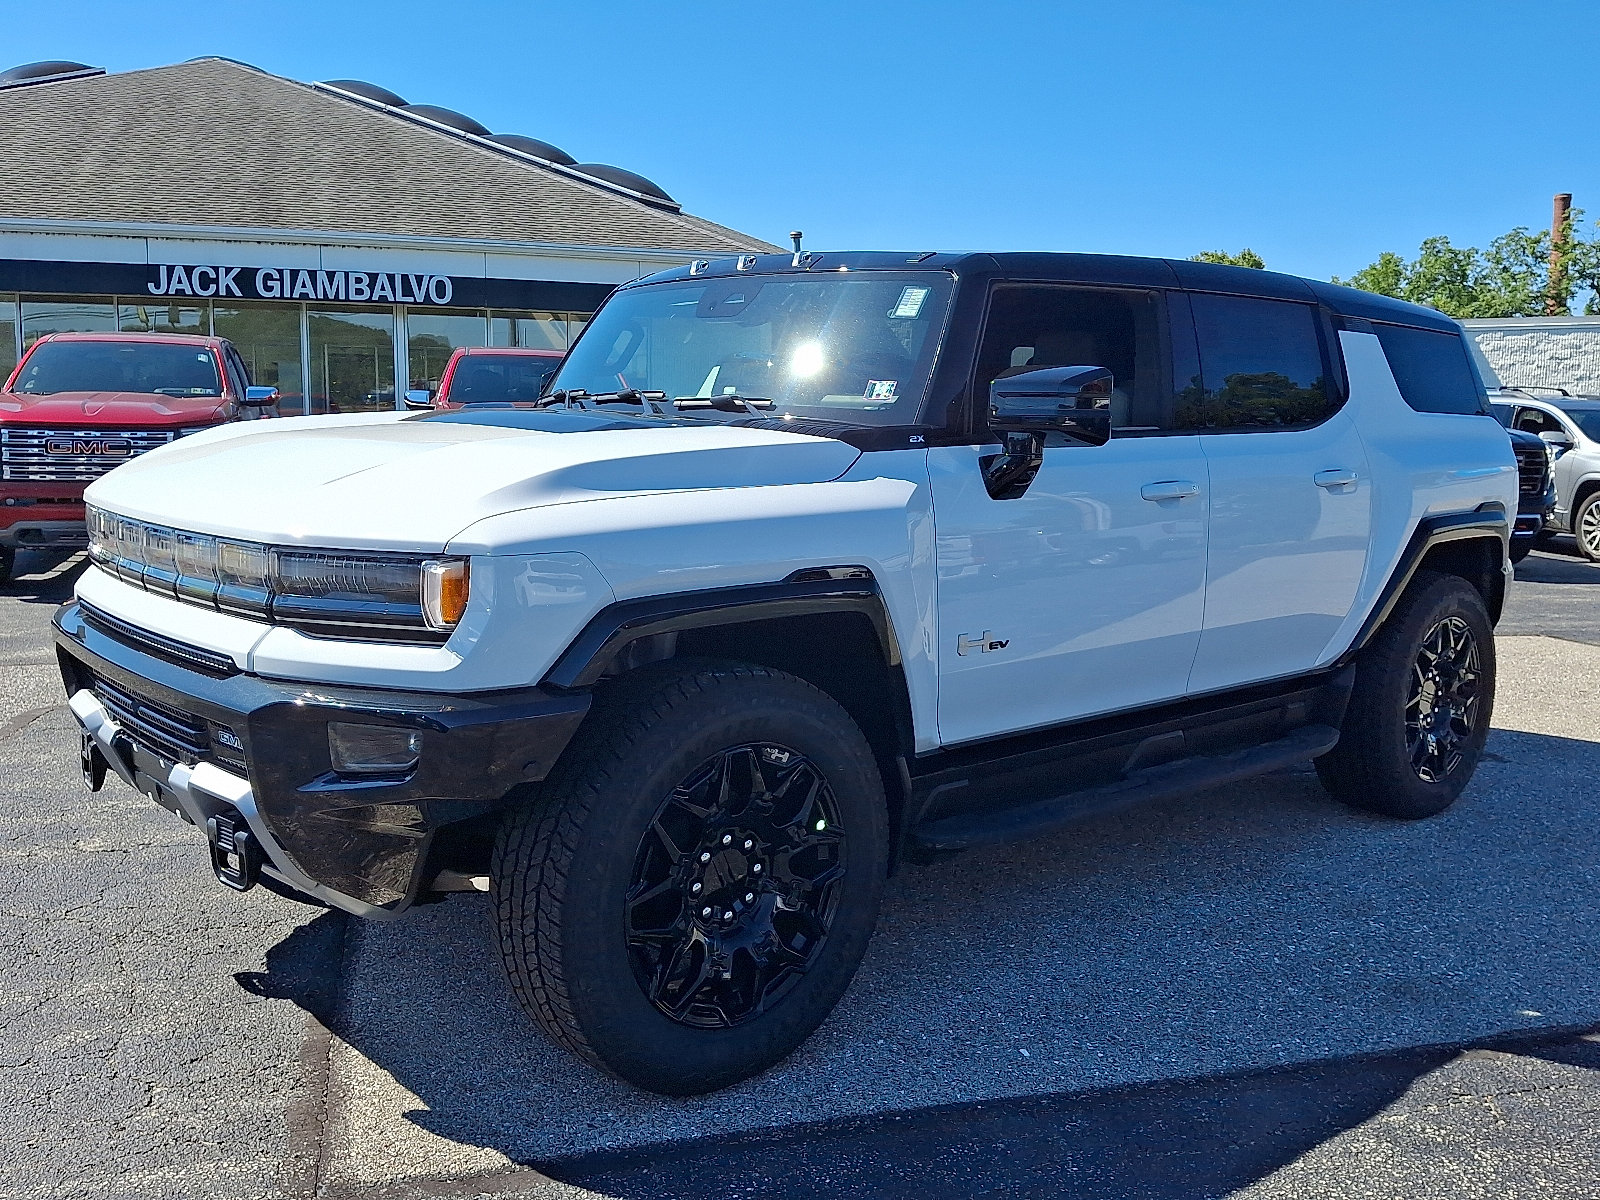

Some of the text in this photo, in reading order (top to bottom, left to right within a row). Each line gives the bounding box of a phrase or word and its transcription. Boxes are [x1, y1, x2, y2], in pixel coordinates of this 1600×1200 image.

[147, 265, 453, 304] JACK GIAMBALVO
[909, 434, 925, 443] 2X
[47, 440, 127, 455] GMC
[218, 730, 244, 750] GM
